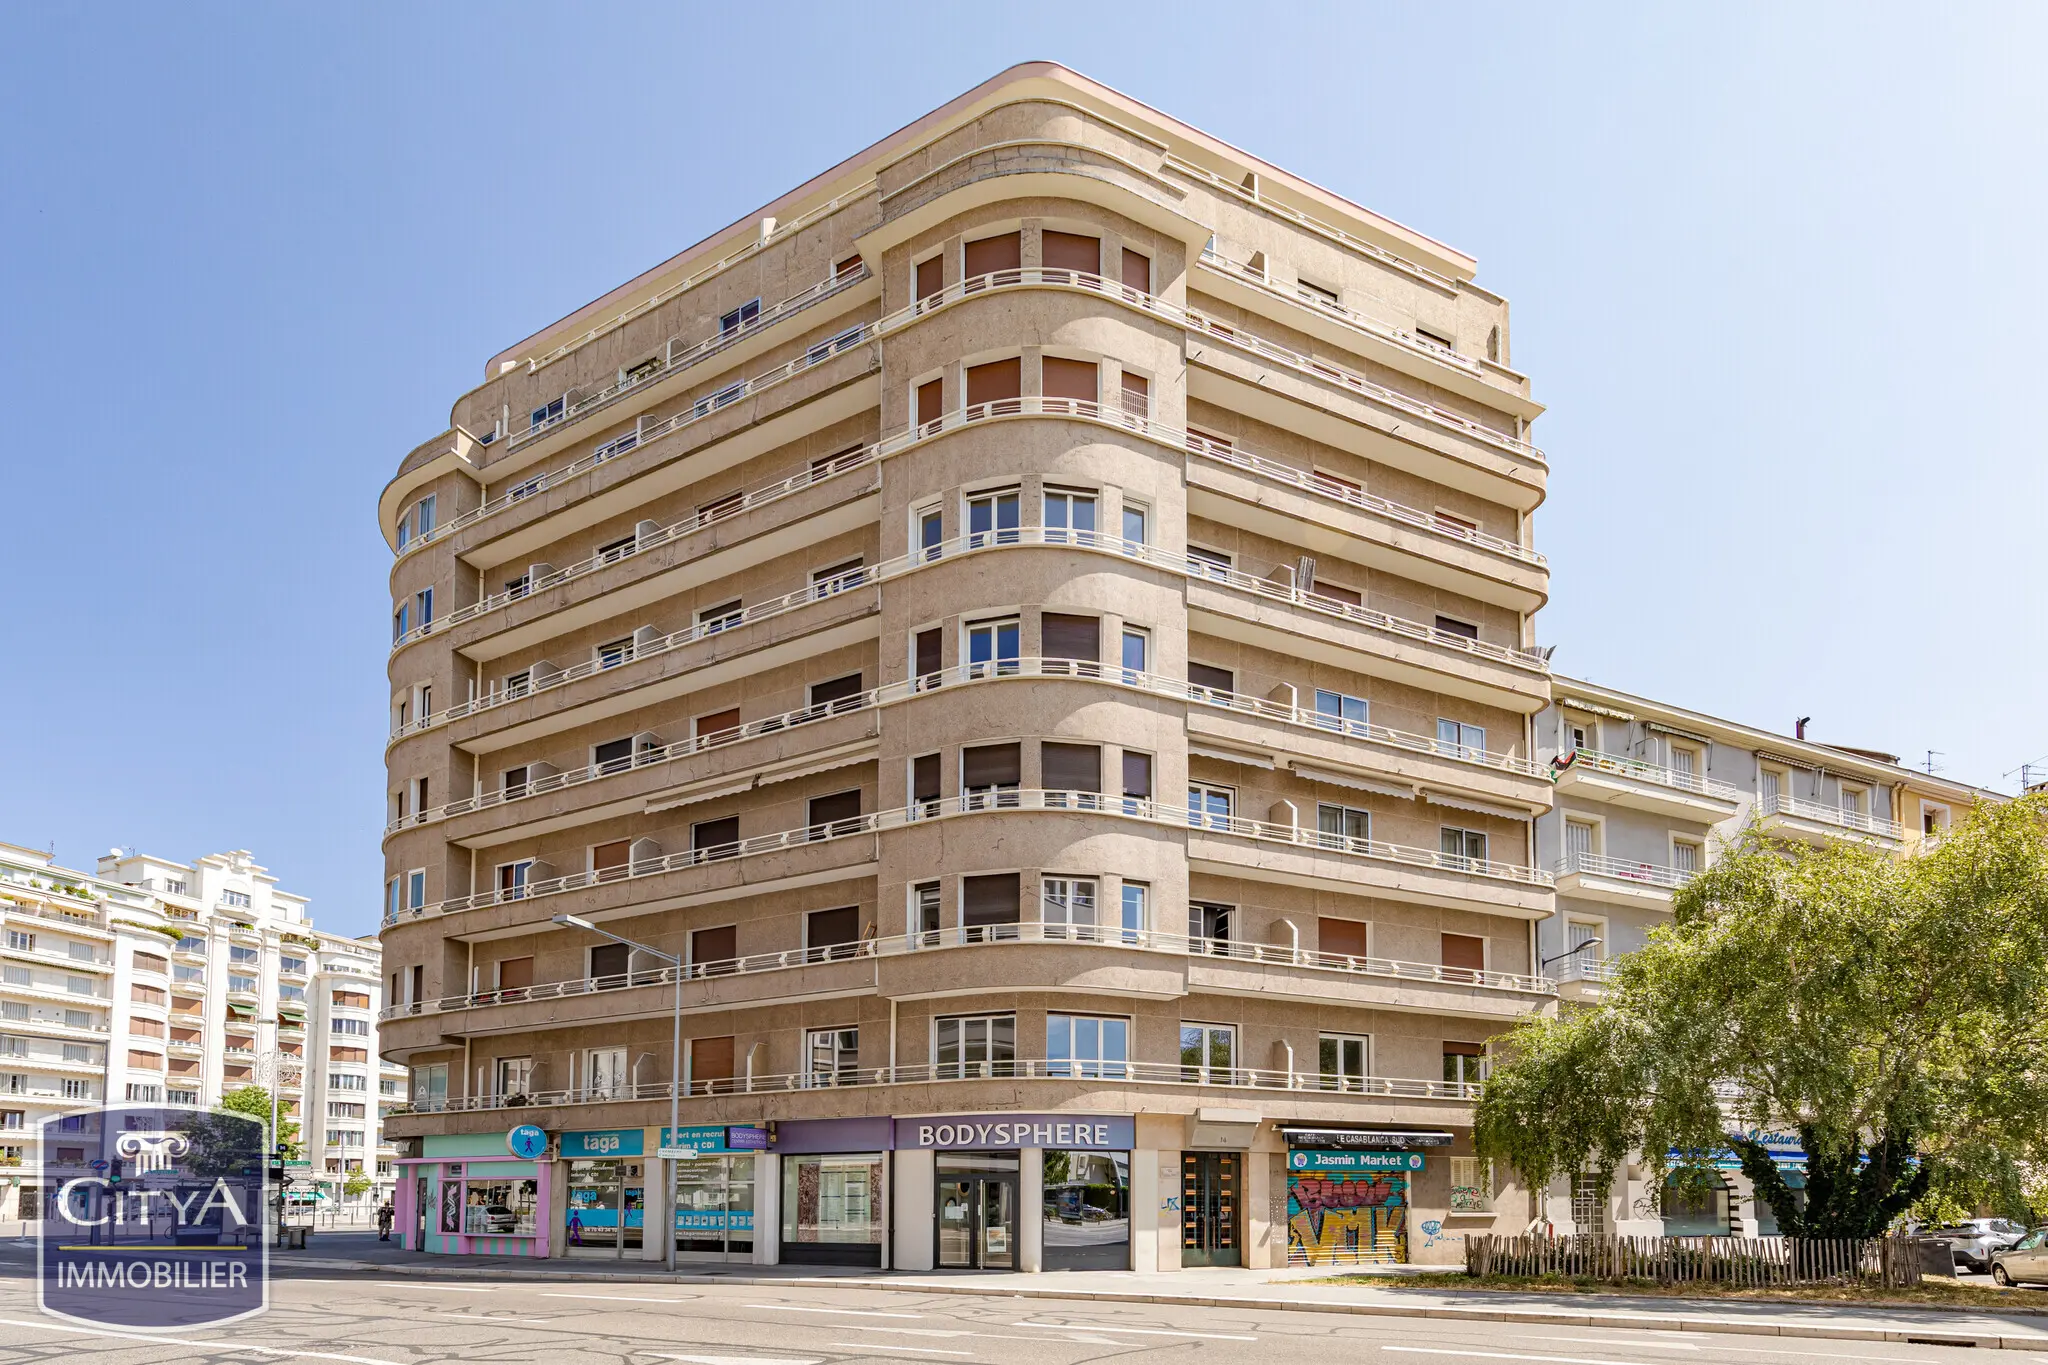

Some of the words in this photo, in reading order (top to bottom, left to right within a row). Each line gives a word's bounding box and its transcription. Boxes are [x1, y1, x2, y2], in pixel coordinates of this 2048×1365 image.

[520, 1129, 539, 1137] taga
[666, 1131, 689, 1139] eert
[919, 1123, 1109, 1146] BODYSPHERE
[1749, 1129, 1802, 1146] Restaura
[583, 1135, 619, 1153] taga
[702, 1141, 715, 1149] CDI
[1315, 1154, 1355, 1165] Jasmin
[1361, 1155, 1401, 1165] Market
